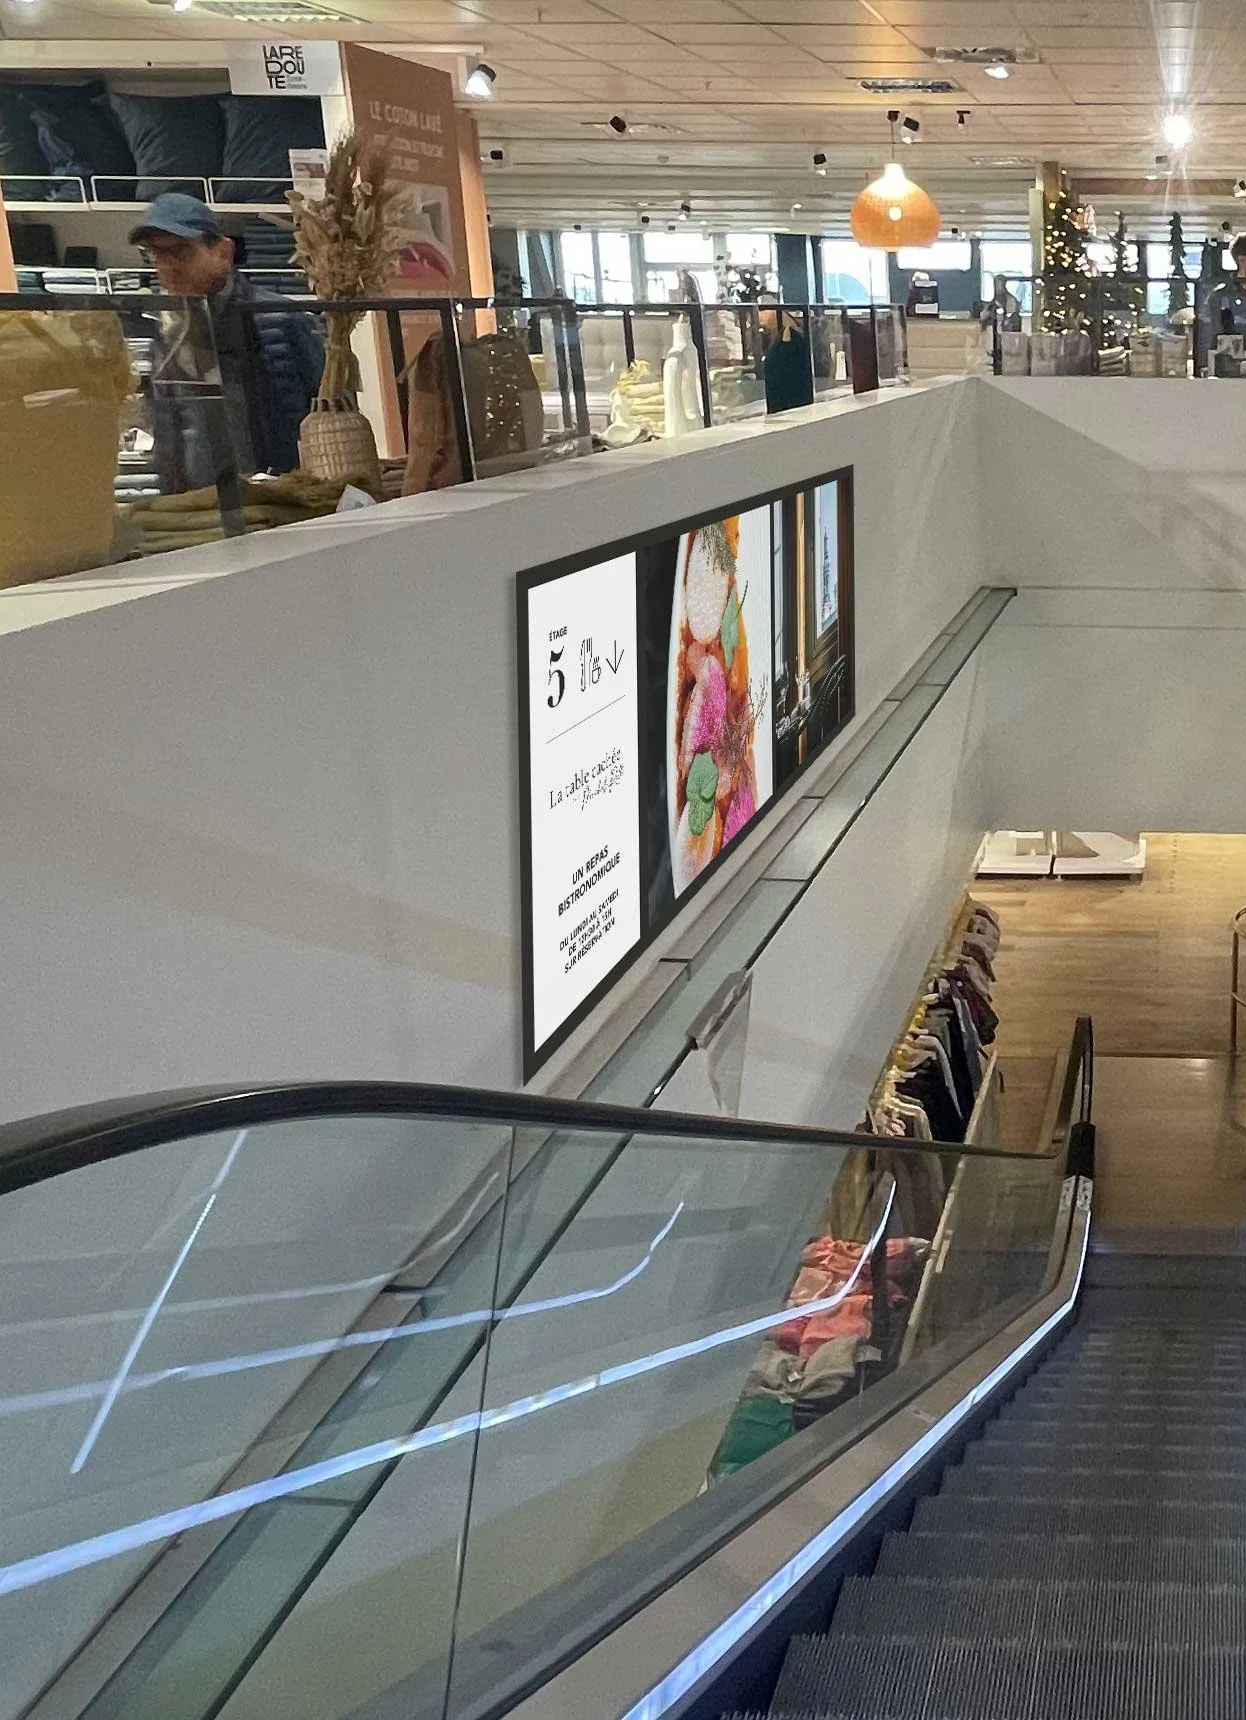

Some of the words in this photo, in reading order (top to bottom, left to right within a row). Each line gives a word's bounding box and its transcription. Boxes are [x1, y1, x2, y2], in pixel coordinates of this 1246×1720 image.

[265, 60, 305, 75] DOU
[267, 75, 286, 89] TE
[547, 645, 565, 708] 5
[550, 789, 563, 808] La
[572, 866, 584, 885] UN
[586, 845, 608, 874] REPAS
[558, 852, 620, 916] BISTRONOMIQUE
[560, 936, 569, 951] DU
[570, 917, 588, 941] LUNDI
